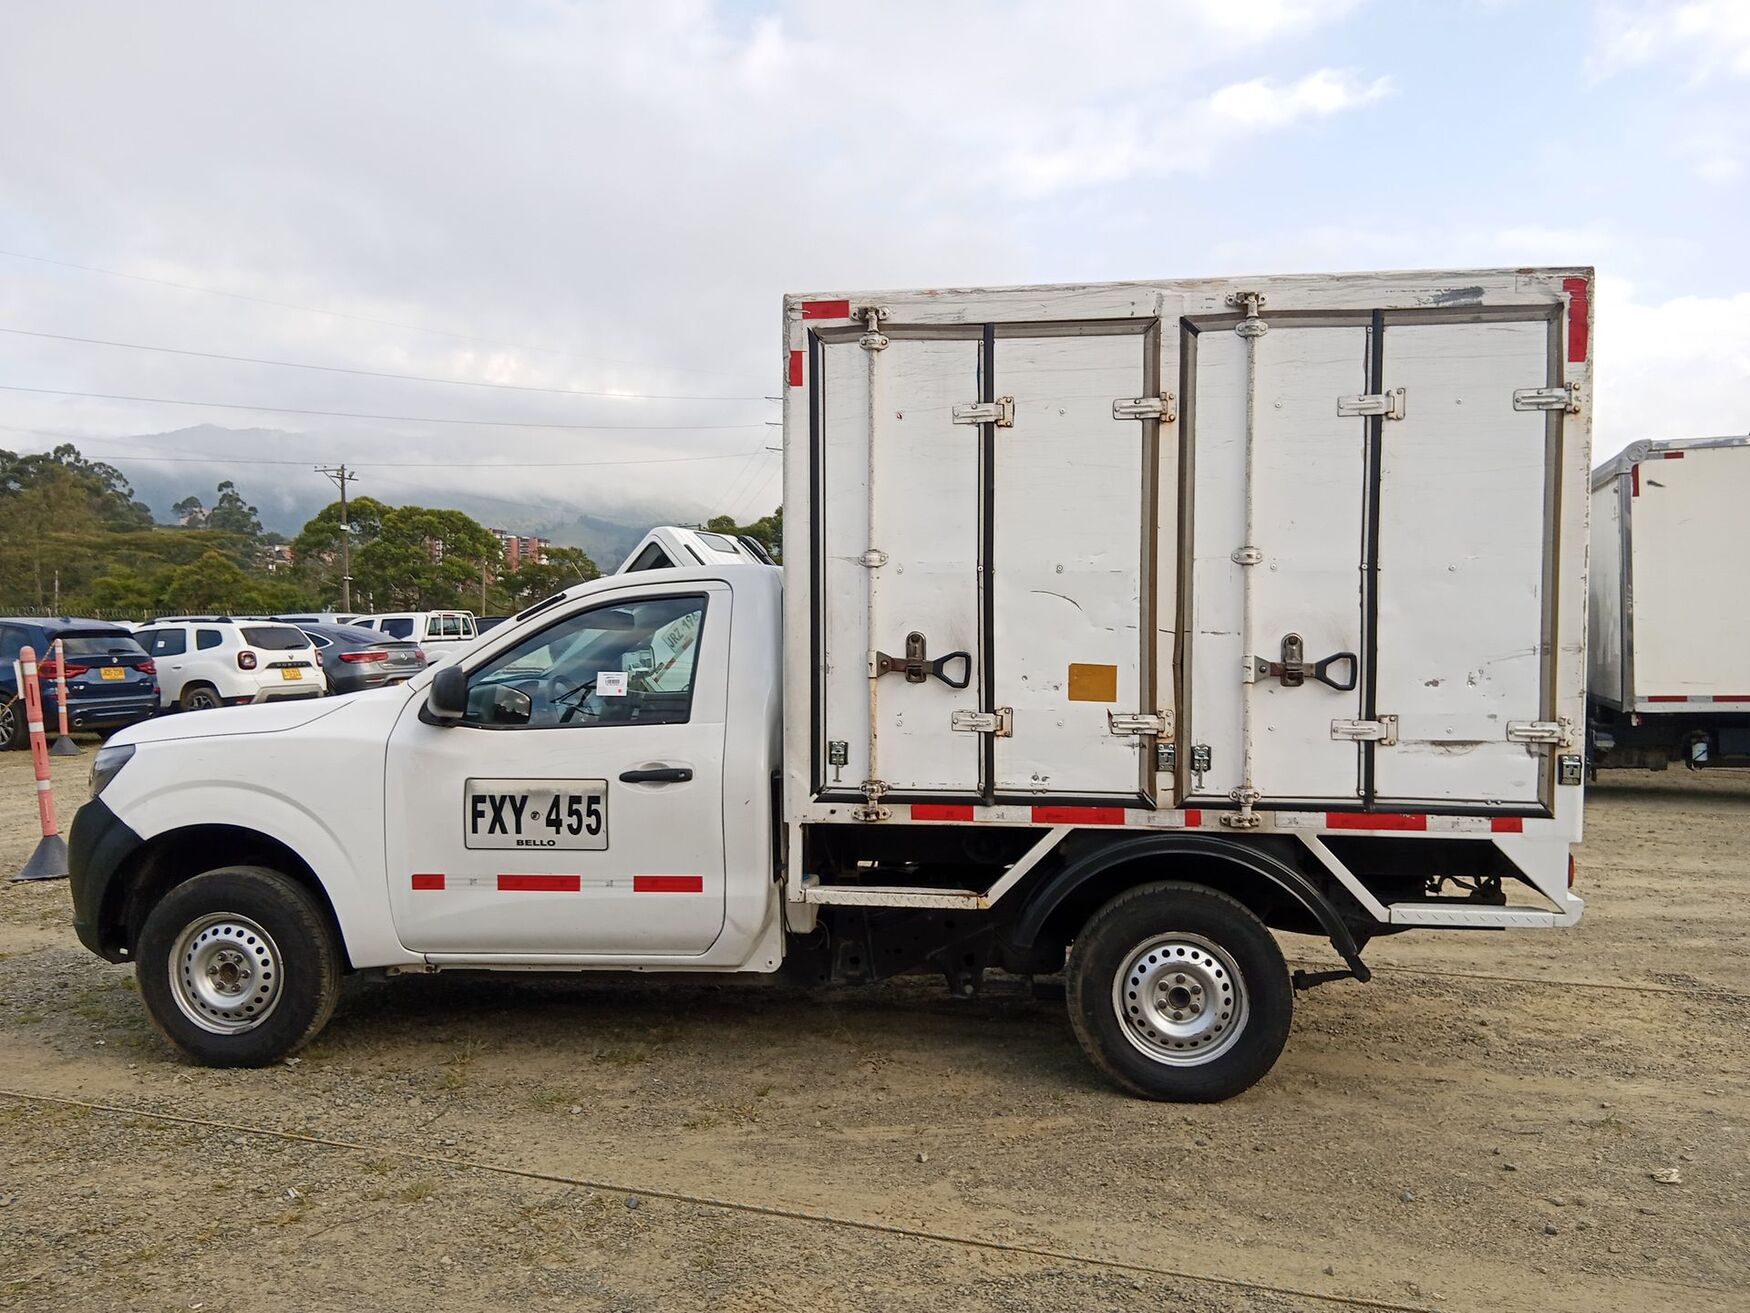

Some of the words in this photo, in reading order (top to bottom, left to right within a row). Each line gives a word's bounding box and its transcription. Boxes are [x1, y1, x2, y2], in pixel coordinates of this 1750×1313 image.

[666, 628, 684, 648] JRZ
[471, 794, 529, 835] FXY
[545, 794, 602, 836] 455
[516, 839, 556, 847] BELLO
